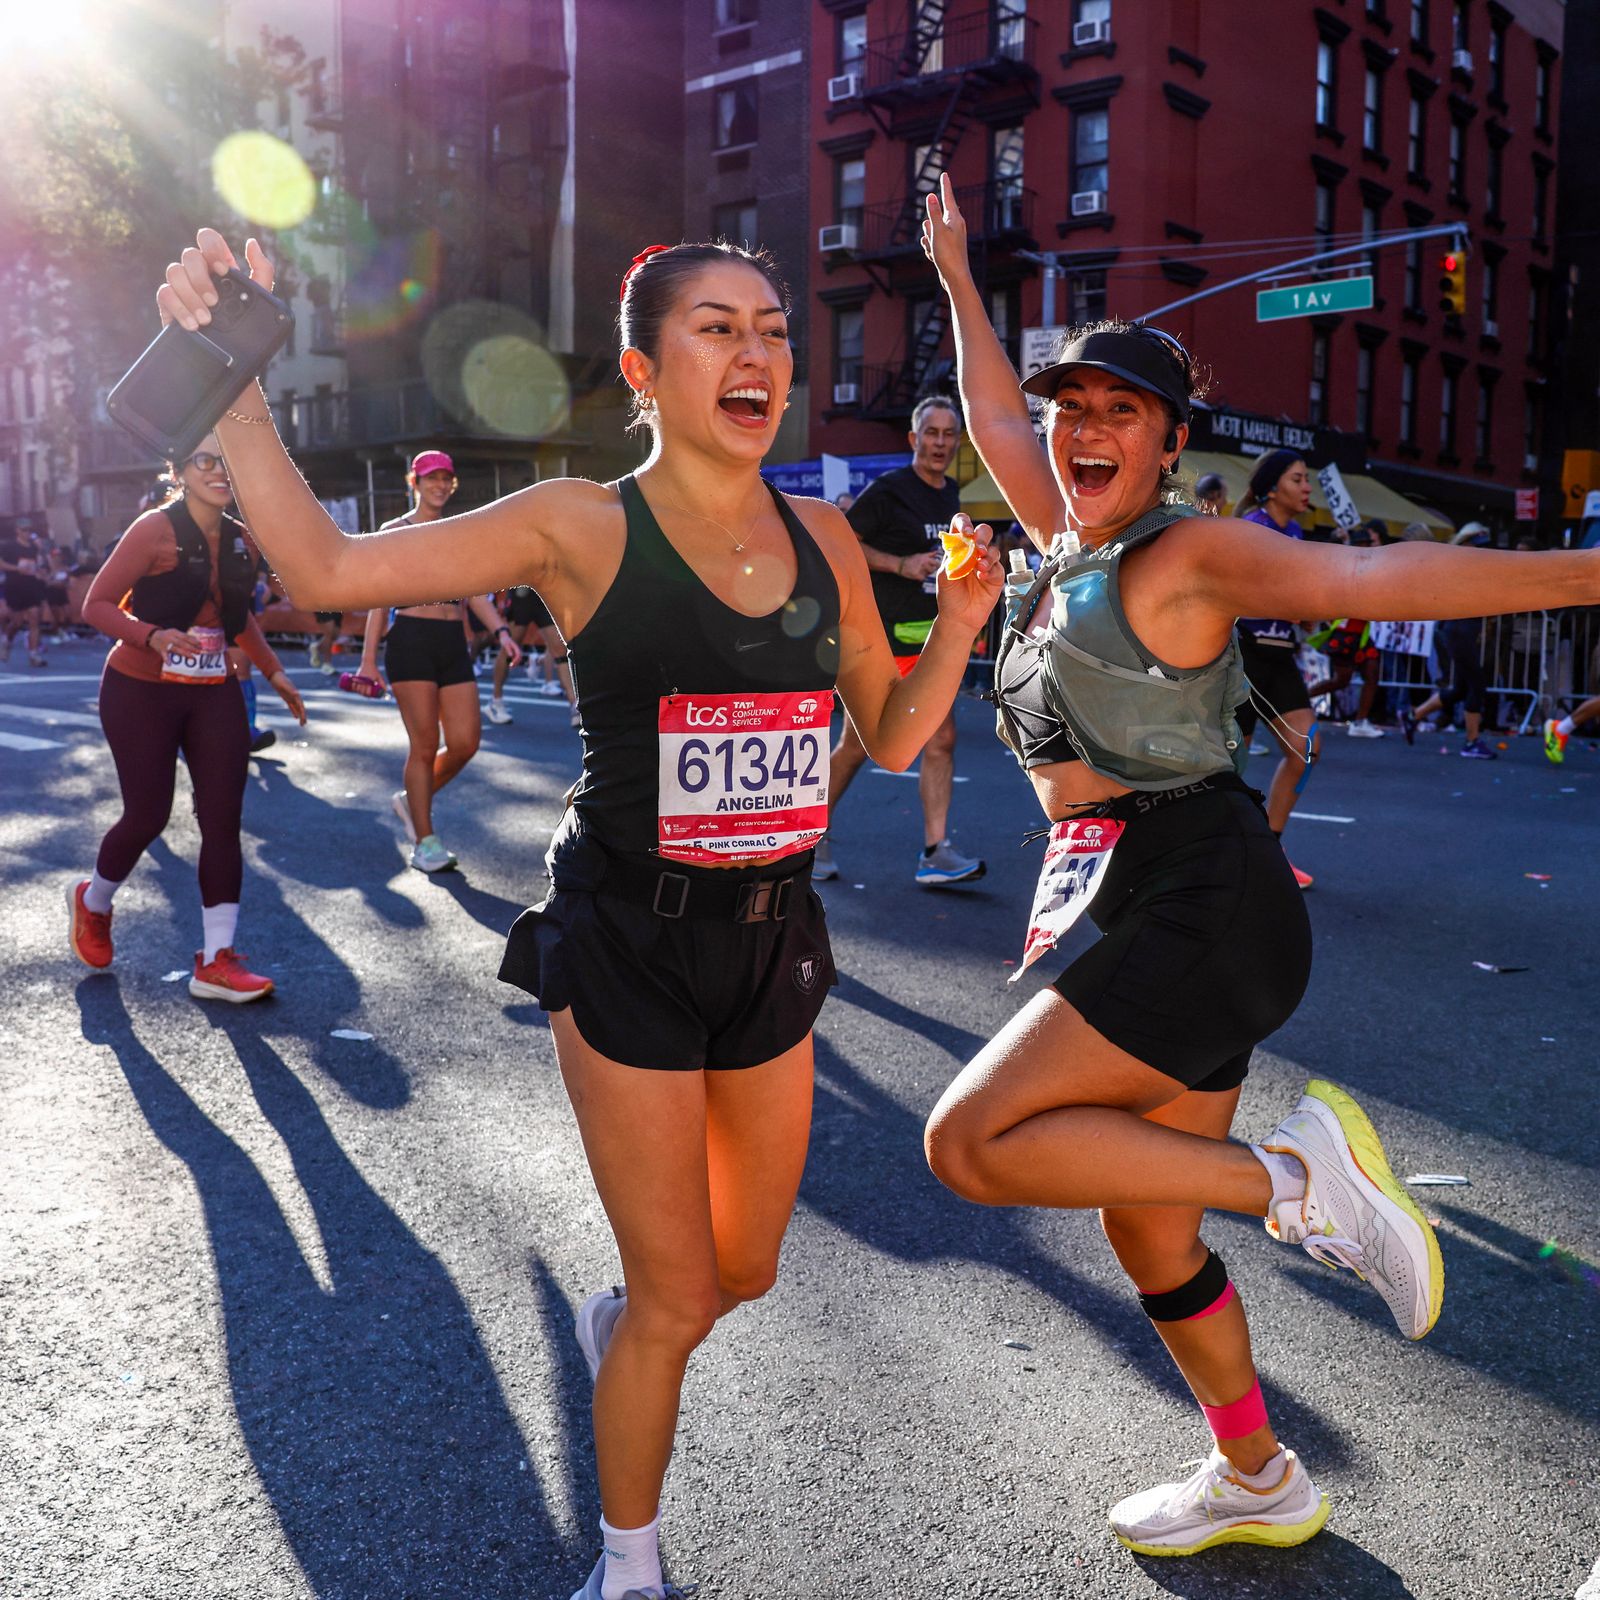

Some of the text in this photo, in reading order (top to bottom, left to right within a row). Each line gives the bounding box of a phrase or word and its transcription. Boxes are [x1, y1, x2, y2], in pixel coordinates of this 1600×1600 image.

[1293, 291, 1332, 309] 1 Av
[801, 473, 824, 488] SHO
[732, 708, 781, 718] CONSULTANCY
[733, 701, 755, 709] TATA
[686, 701, 728, 727] tcs
[677, 733, 820, 793] 61342
[716, 793, 793, 812] ANGELINA
[693, 840, 703, 849] 5
[709, 841, 731, 849] PINK
[732, 839, 766, 848] CORRAL
[766, 835, 777, 847] C
